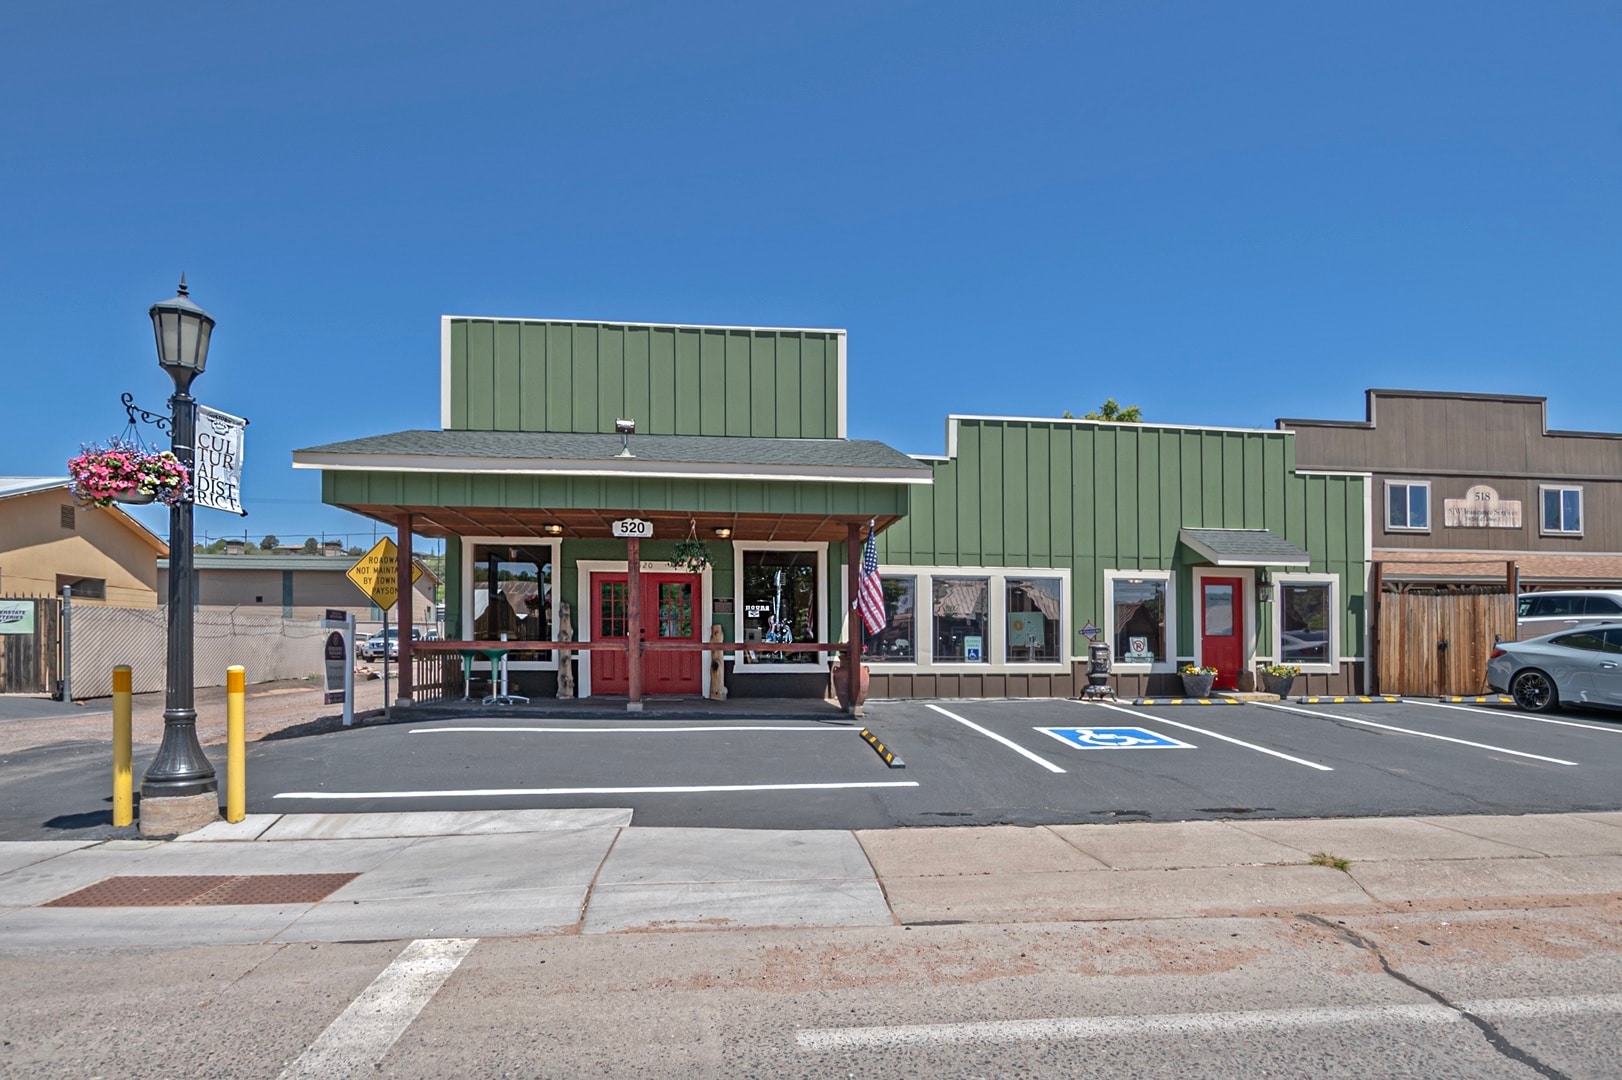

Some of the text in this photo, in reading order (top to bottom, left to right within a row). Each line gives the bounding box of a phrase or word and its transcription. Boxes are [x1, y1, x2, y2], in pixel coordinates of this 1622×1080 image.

[198, 432, 235, 456] CUL
[198, 446, 233, 470] TUR
[197, 462, 219, 481] AL
[198, 475, 236, 499] DIST
[198, 490, 237, 510] RICT
[1475, 491, 1491, 502] 518
[620, 522, 645, 534] 520
[368, 556, 399, 565] ROADWA
[356, 567, 370, 575] NOT
[363, 576, 396, 585] BY TOWN
